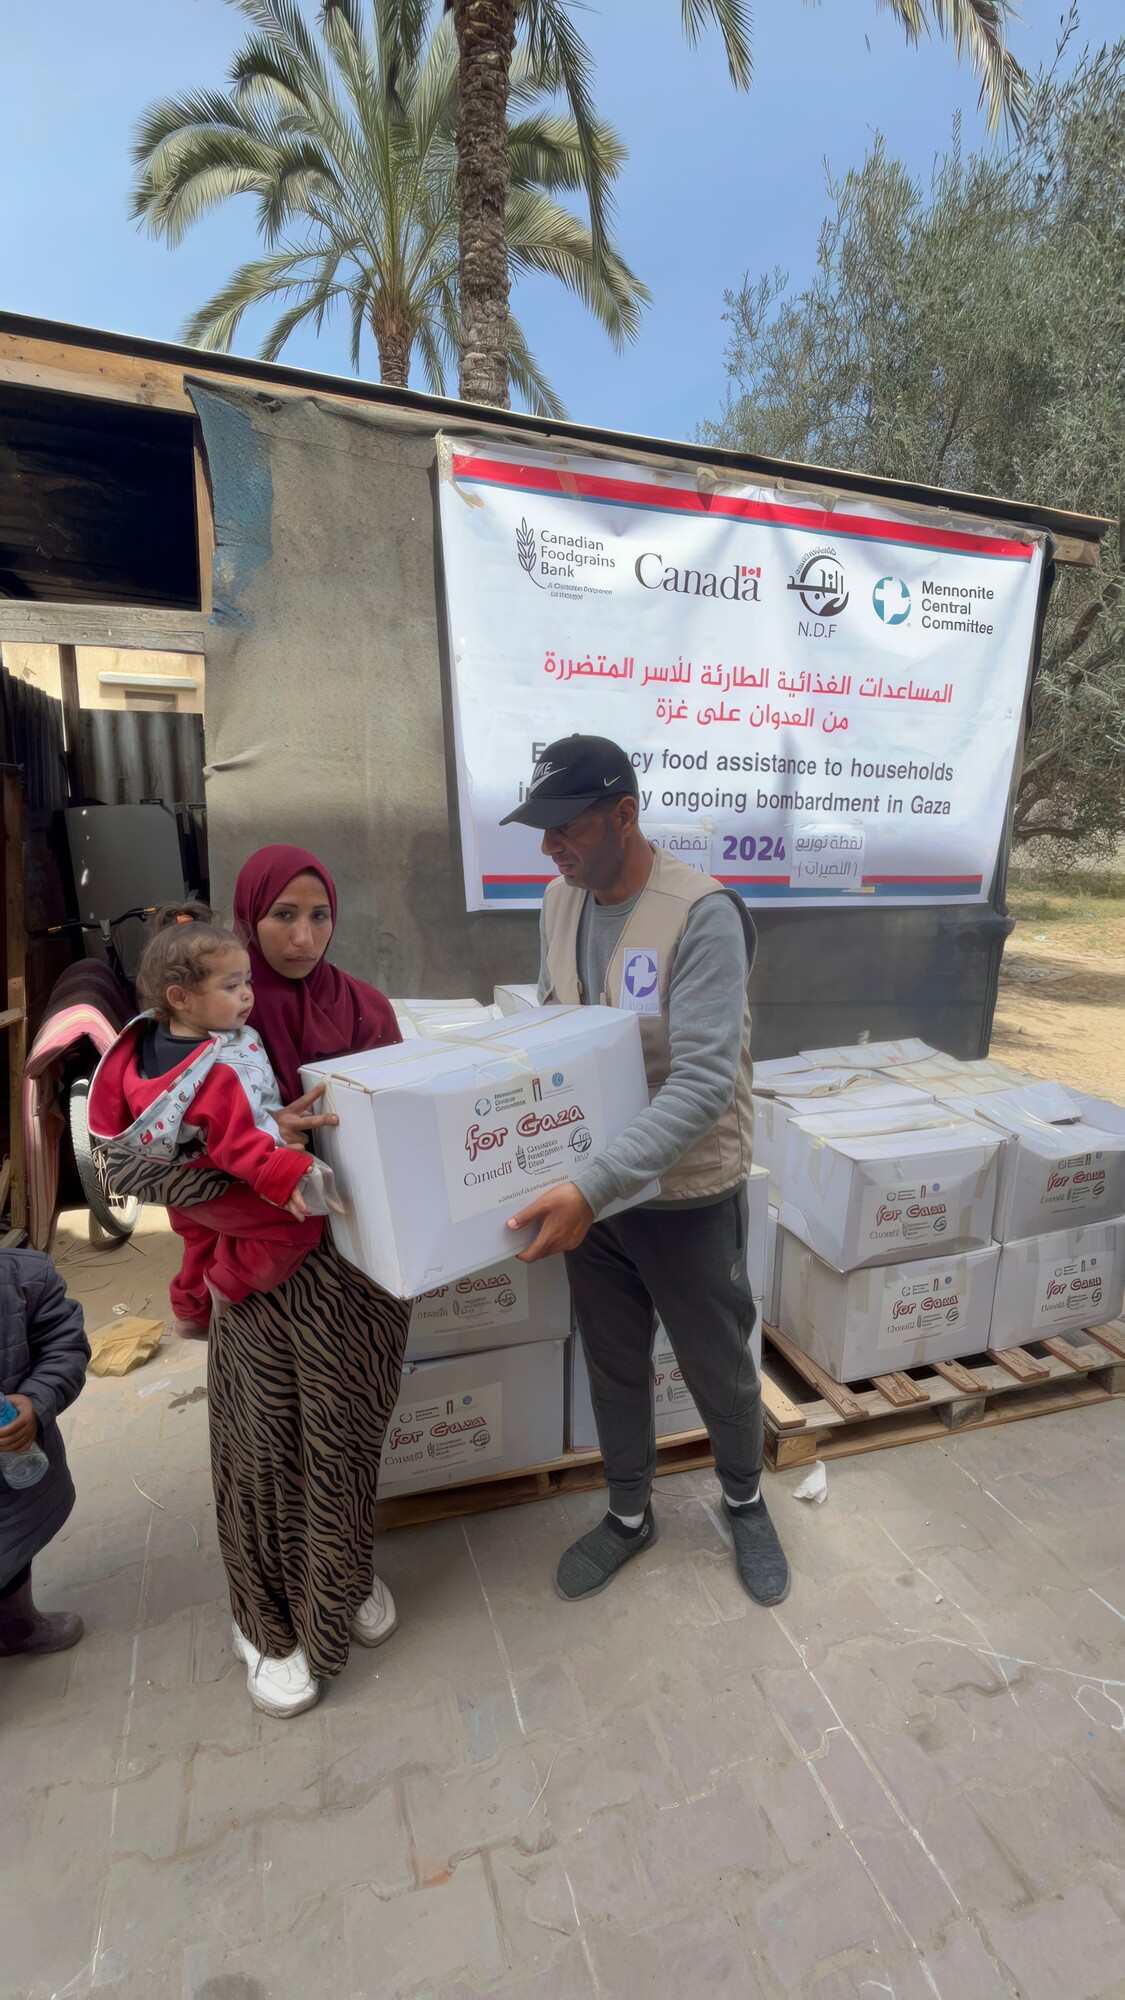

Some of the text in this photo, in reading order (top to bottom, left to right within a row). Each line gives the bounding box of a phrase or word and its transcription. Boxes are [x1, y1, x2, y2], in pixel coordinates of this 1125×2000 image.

[541, 530, 604, 551] Canadian
[541, 546, 616, 568] Foodgrains
[541, 562, 575, 578] Bank
[634, 552, 762, 602] Canada
[922, 580, 995, 600] Mennonite
[921, 598, 971, 616] Central
[797, 621, 838, 638] N.D.F
[921, 616, 994, 635] Committee
[544, 651, 953, 703] المساعدات الغذائية الطارئة للأسر المتضررة
[656, 697, 849, 733] من العدوان على غزة
[662, 749, 708, 770] food
[717, 752, 817, 775] assistance
[824, 758, 843, 776] to
[850, 758, 954, 781] households
[640, 788, 951, 815] y ongoing bombardment in Gaza
[722, 835, 786, 861] 2024
[465, 1124, 509, 1162] for
[515, 1105, 585, 1137] Gaza
[876, 1204, 902, 1226] for
[415, 1284, 449, 1304] or
[893, 1300, 917, 1320] for
[389, 1427, 424, 1450] for
